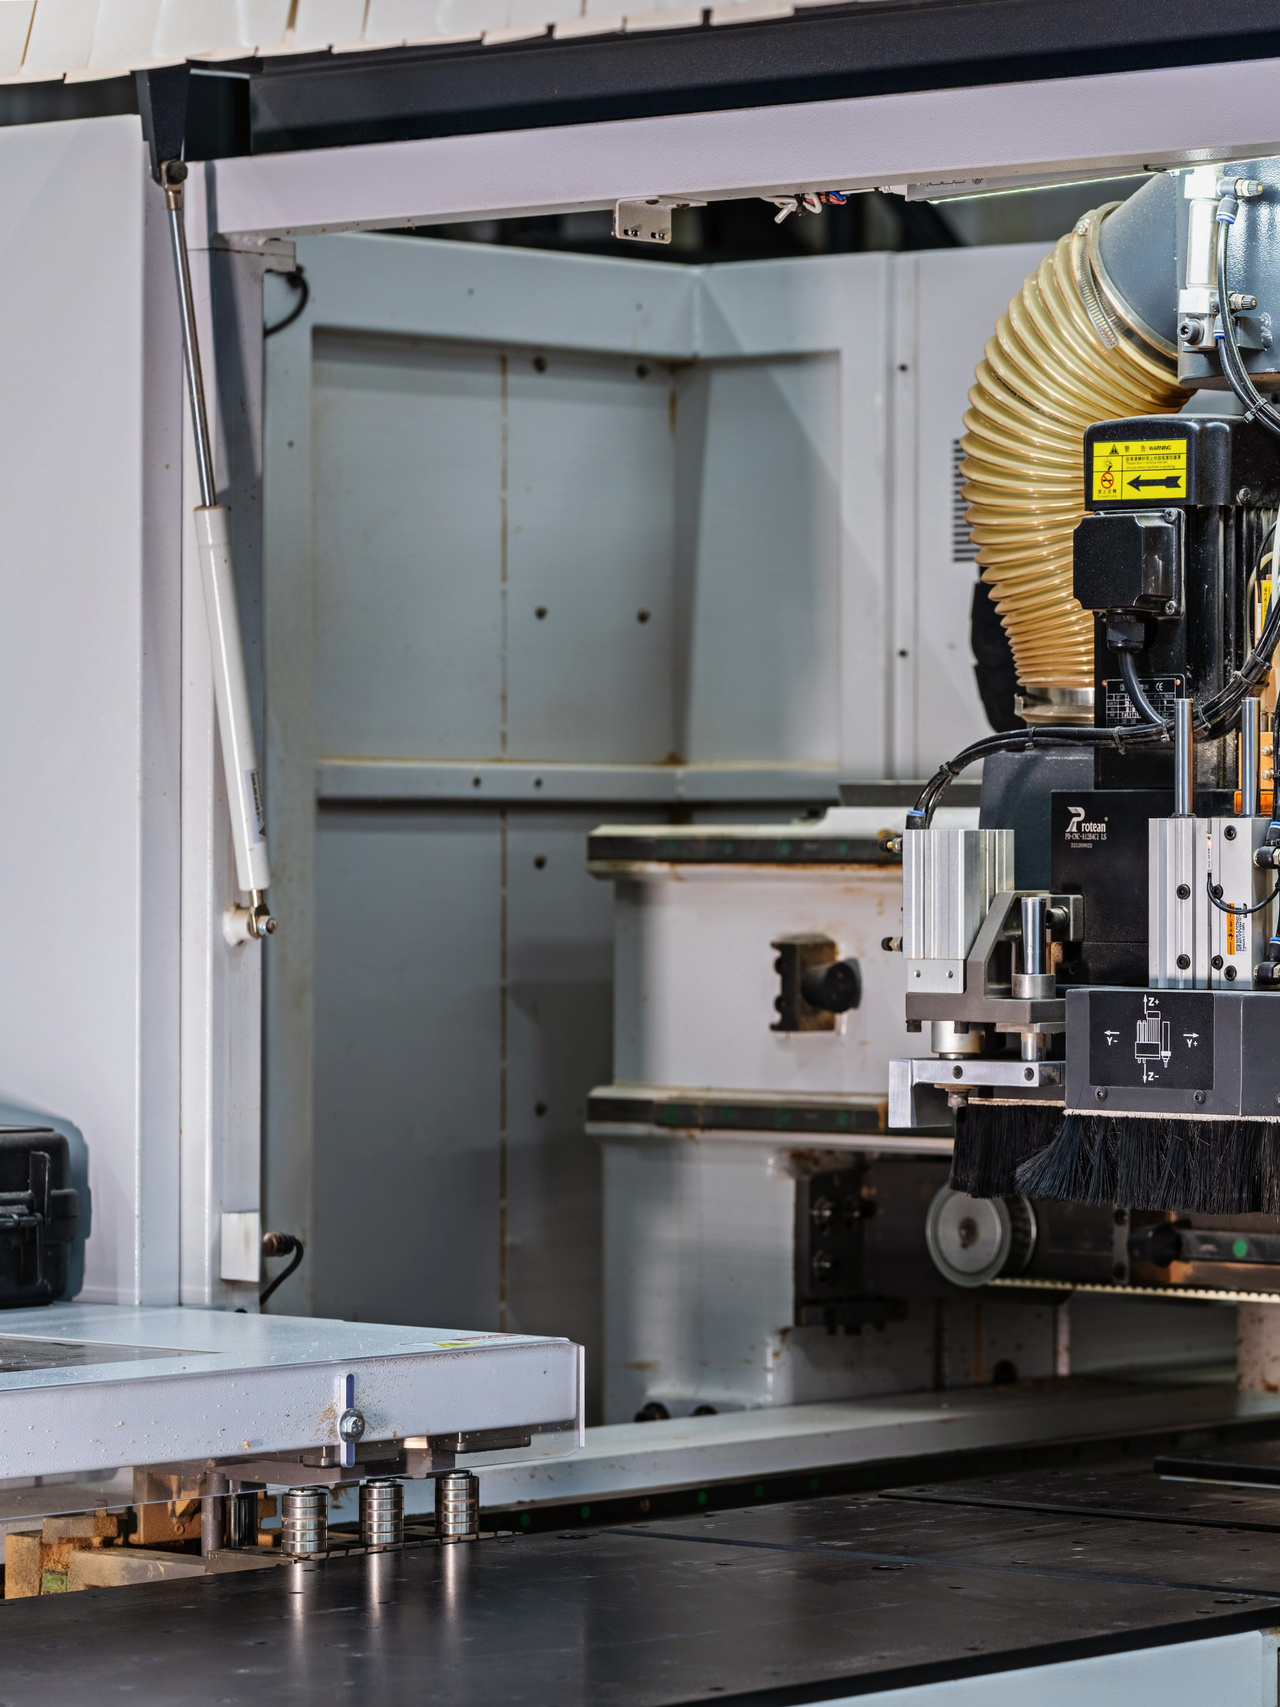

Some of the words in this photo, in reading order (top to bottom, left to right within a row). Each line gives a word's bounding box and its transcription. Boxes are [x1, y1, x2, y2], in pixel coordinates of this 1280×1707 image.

[1148, 997, 1160, 1007] Z+
[1106, 1036, 1118, 1046] Y-
[1186, 1039, 1198, 1048] Y+
[1147, 1072, 1159, 1081] Z-
